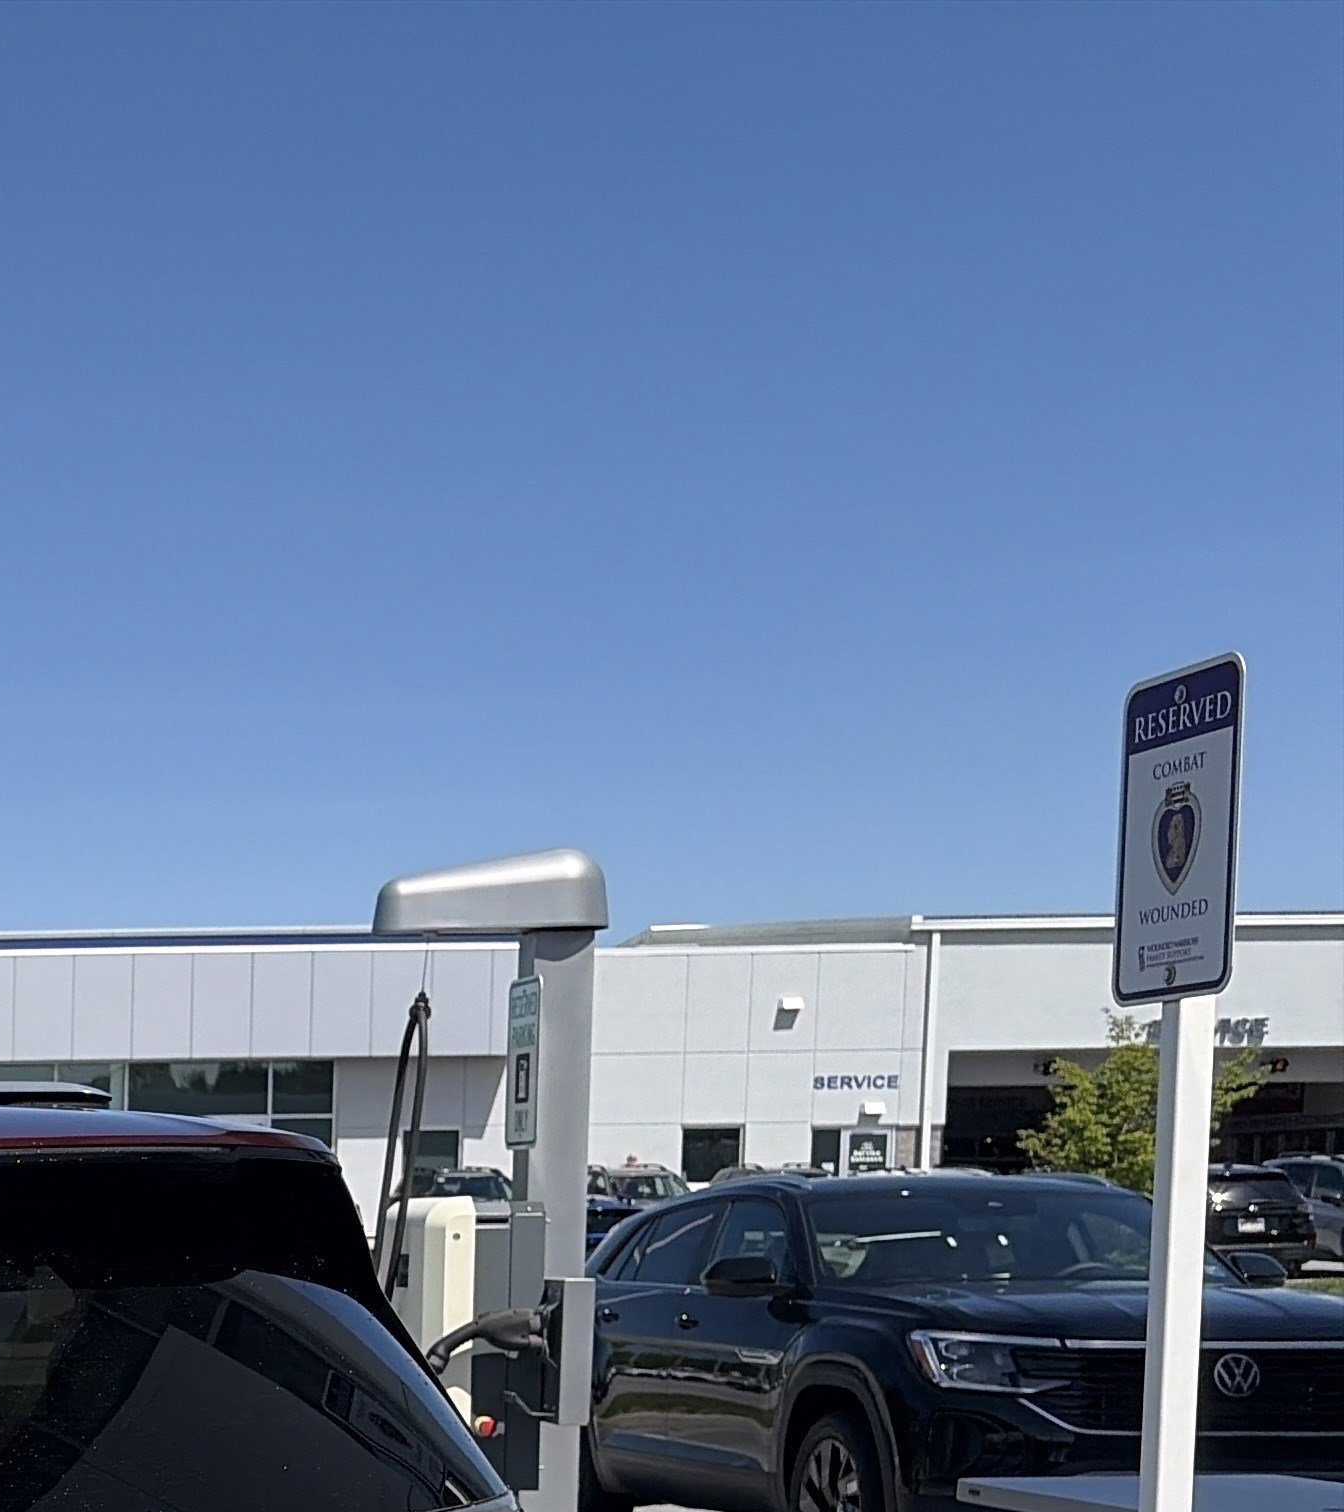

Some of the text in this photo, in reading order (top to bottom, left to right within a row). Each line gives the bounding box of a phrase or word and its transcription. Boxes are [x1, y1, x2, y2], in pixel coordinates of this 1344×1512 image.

[1134, 690, 1232, 744] RESERVED
[1153, 751, 1207, 781] COMBAT
[1138, 899, 1209, 925] WOUNDED
[813, 1075, 899, 1090] SERVICE
